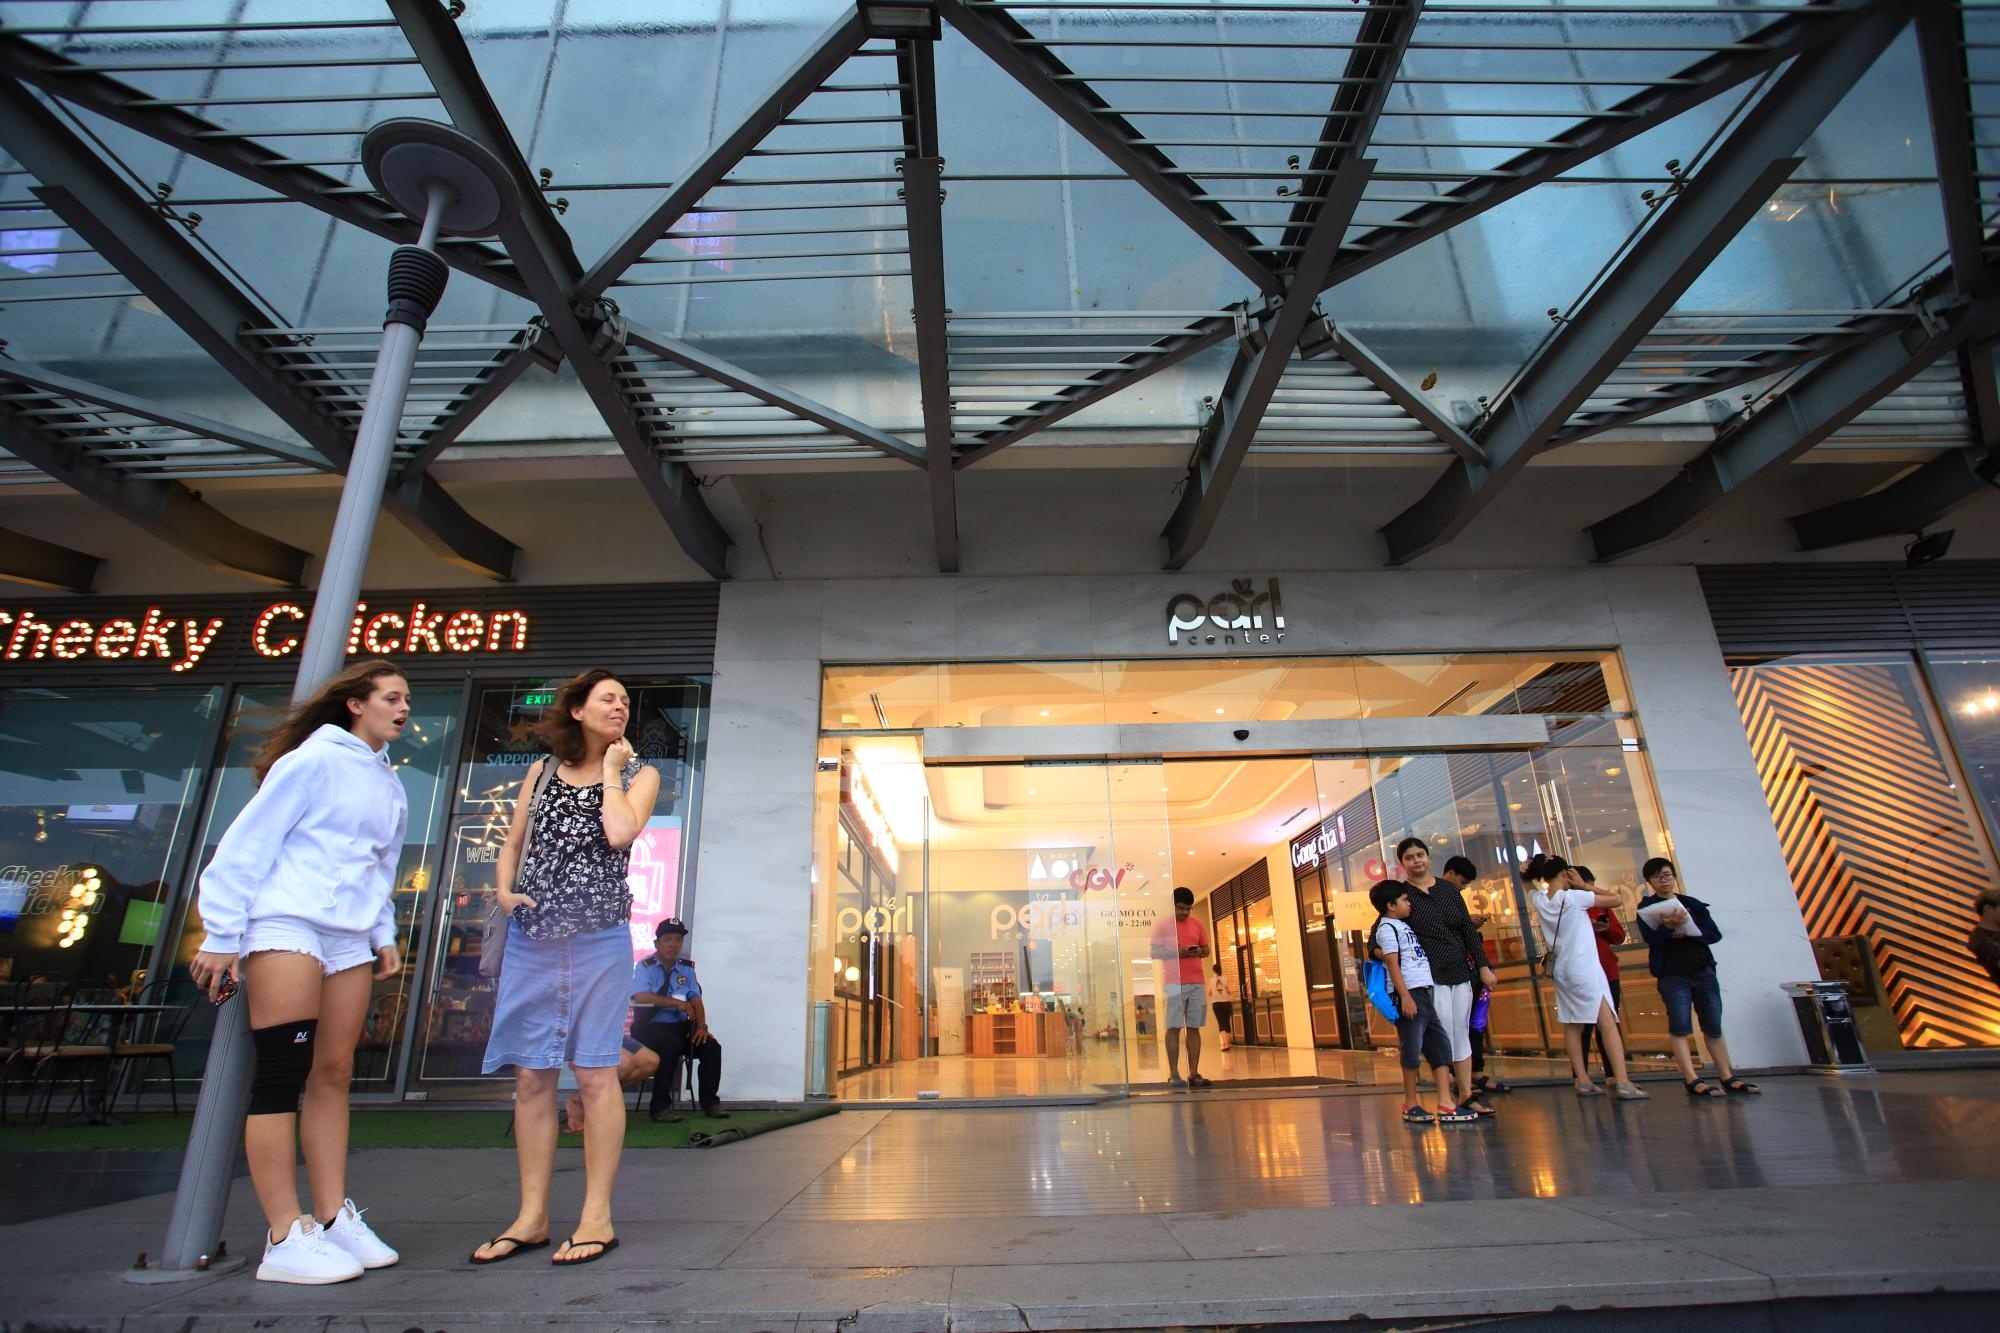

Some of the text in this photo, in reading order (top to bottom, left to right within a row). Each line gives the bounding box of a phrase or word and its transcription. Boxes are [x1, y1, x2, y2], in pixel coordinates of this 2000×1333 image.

[252, 600, 527, 658] Cicken
[1187, 630, 1286, 646] center
[525, 694, 554, 705] EXIT
[466, 846, 503, 863] WEL
[1292, 838, 1320, 868] Gong
[1318, 825, 1338, 854] cha
[1069, 868, 1126, 892] CGV
